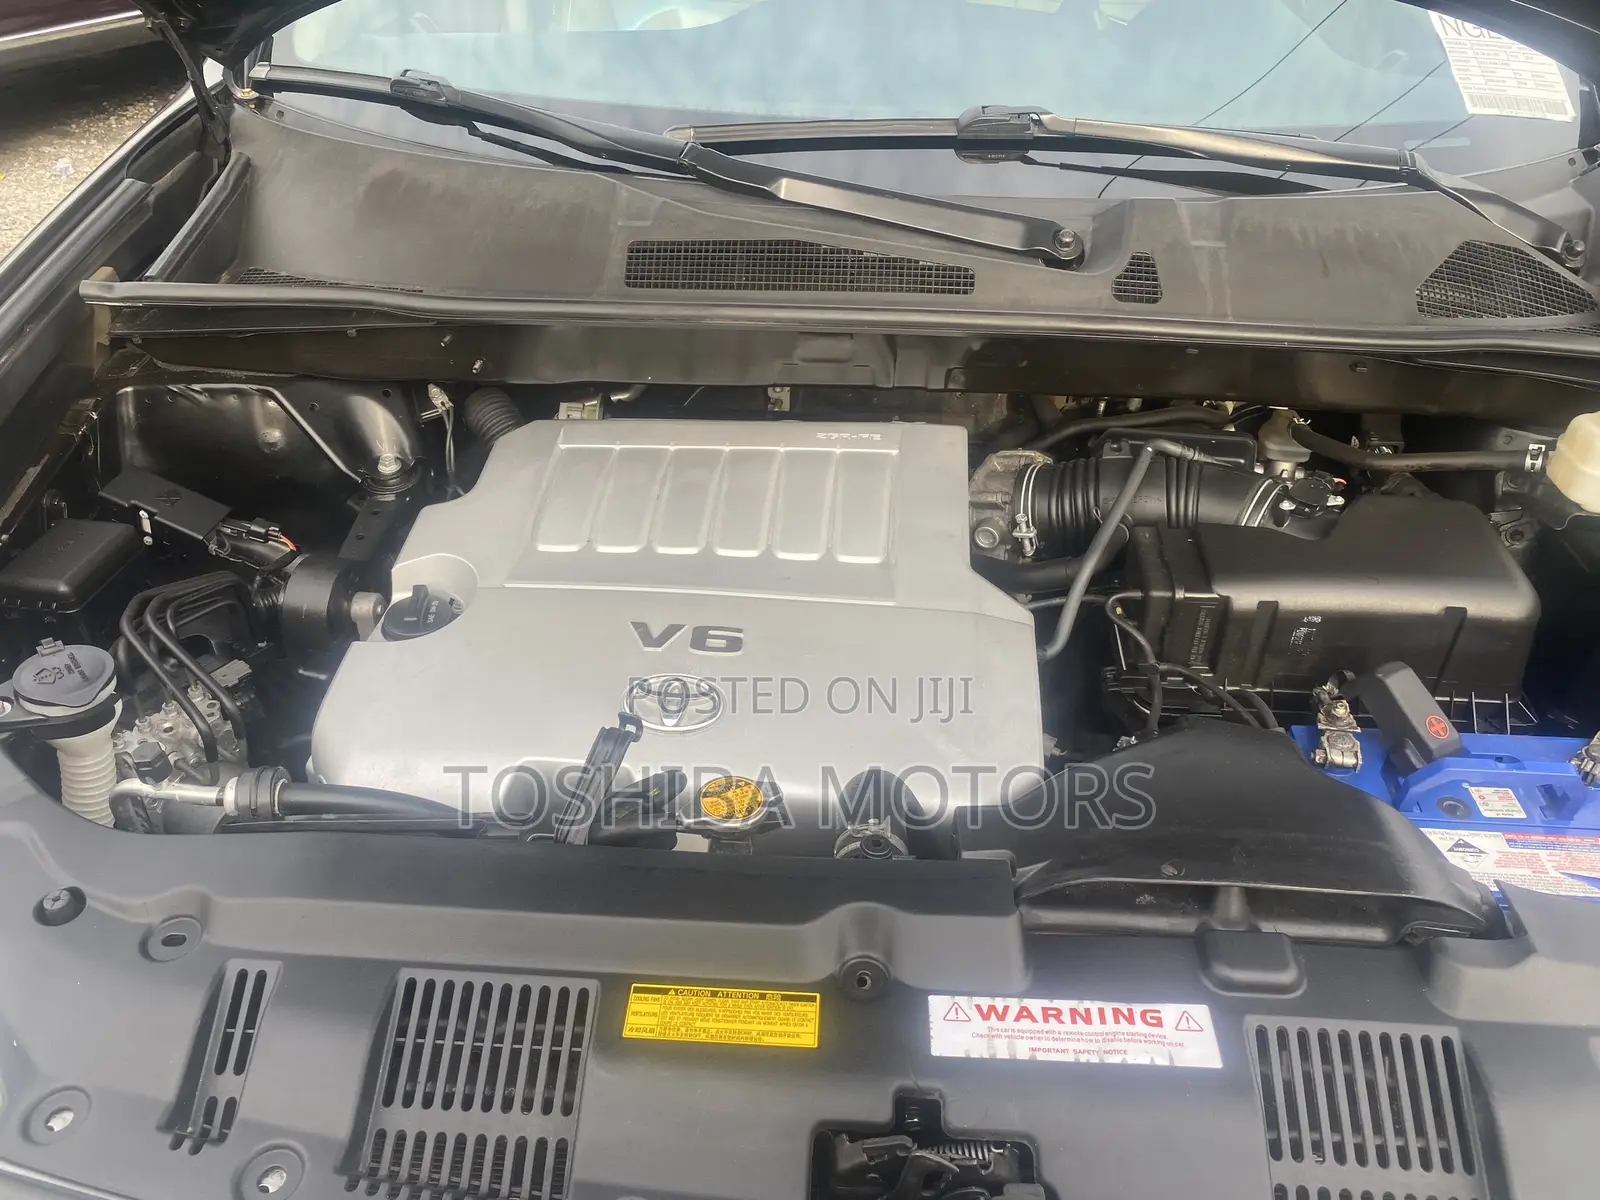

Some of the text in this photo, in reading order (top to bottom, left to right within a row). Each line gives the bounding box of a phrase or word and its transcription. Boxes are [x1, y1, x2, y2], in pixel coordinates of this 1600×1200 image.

[628, 621, 744, 657] V6
[677, 988, 760, 1000] CAUTION ATTENTION
[974, 1003, 1164, 1028] WARNING
[1028, 1046, 1070, 1054] IMPORTANT
[1102, 1048, 1128, 1056] NOTICE
